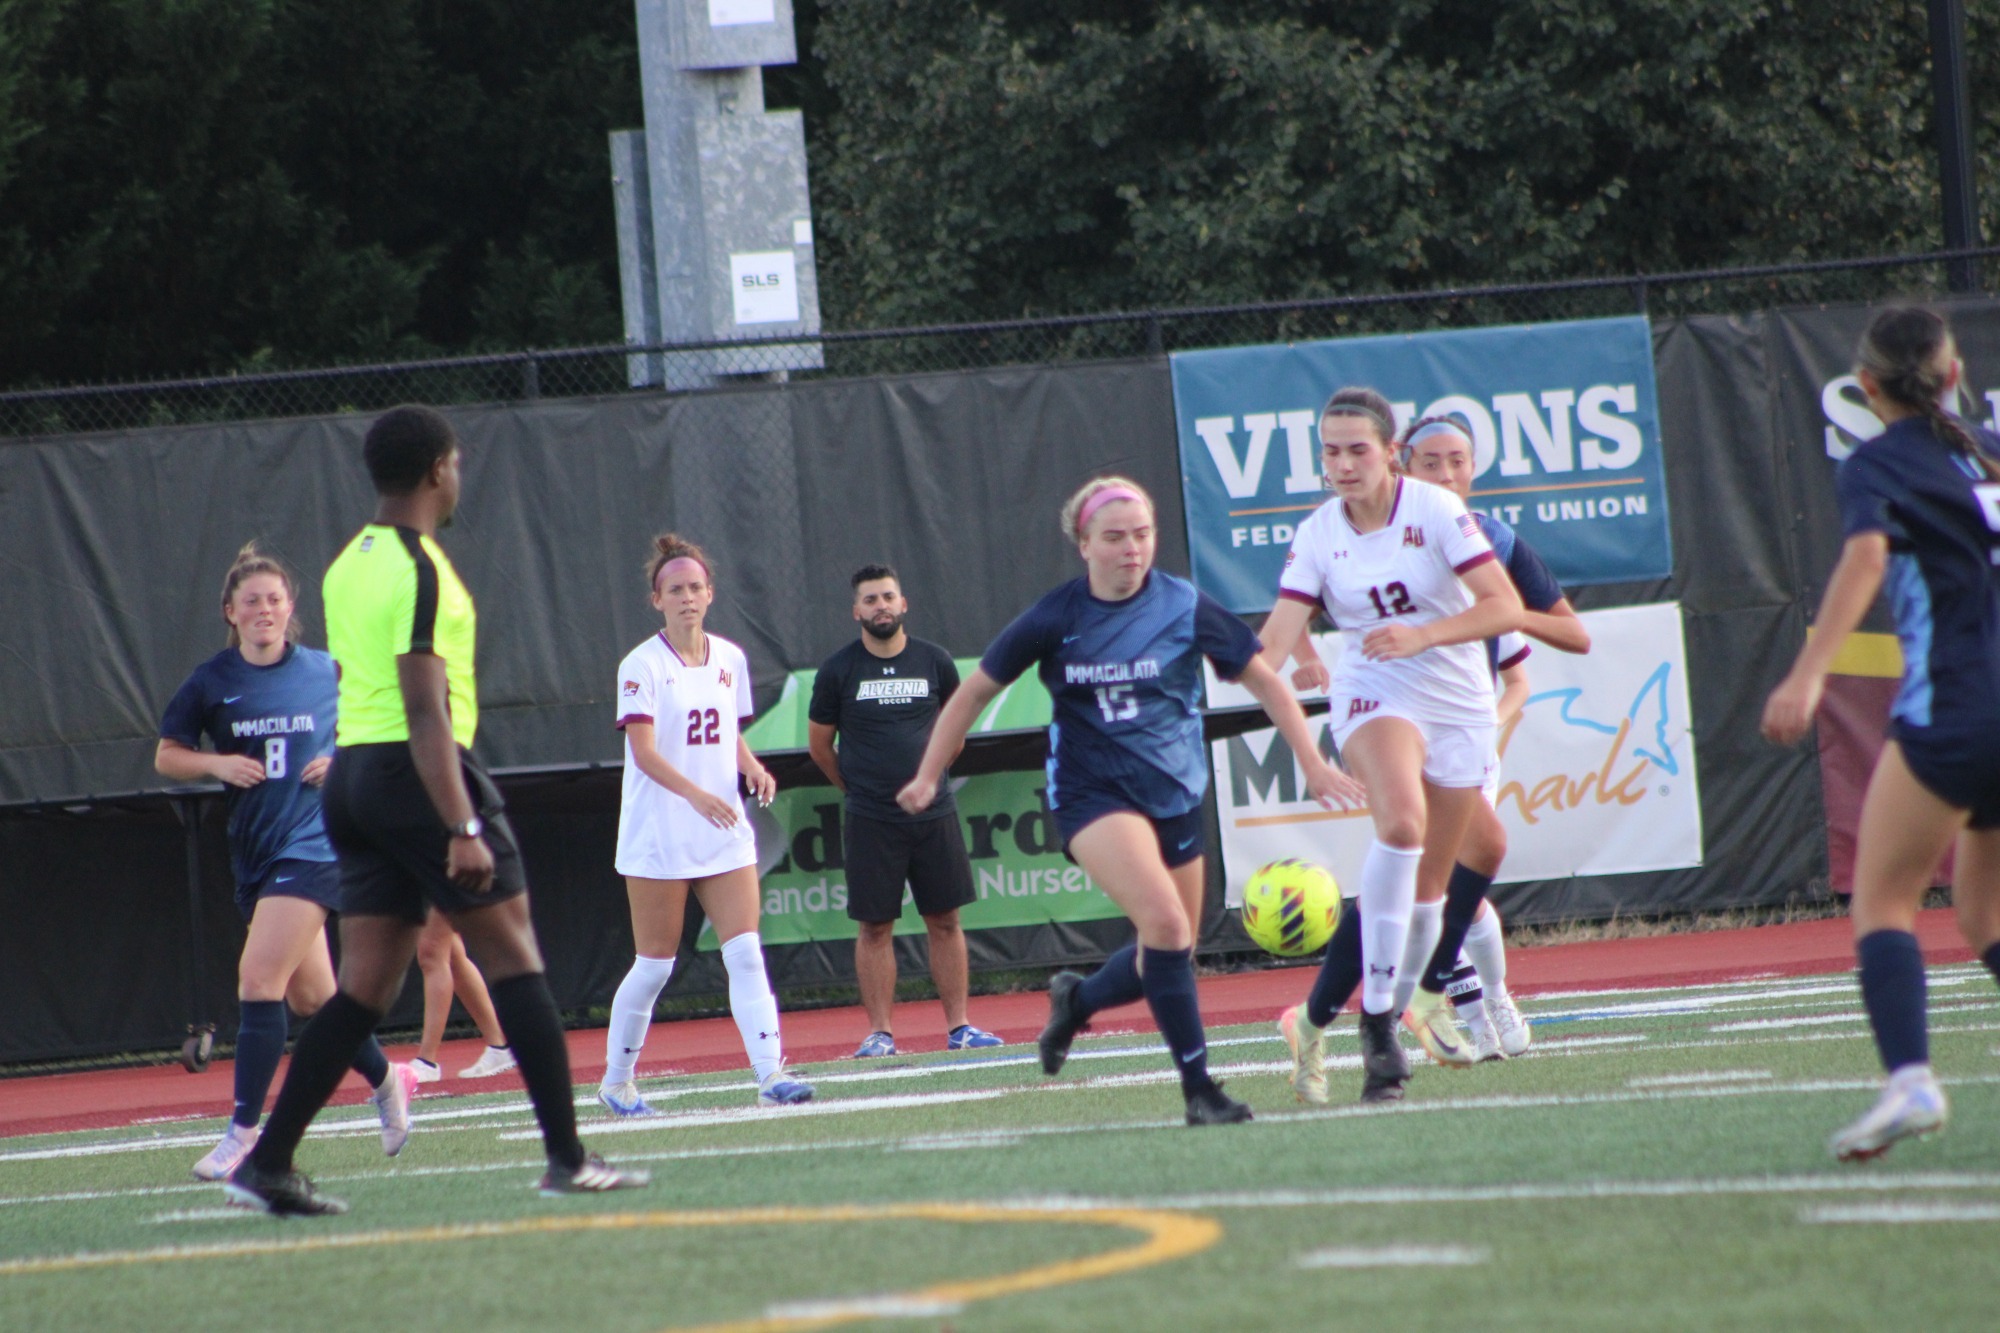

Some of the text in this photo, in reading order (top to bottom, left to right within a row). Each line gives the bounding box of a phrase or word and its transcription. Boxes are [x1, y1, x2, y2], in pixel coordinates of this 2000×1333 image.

[742, 273, 780, 287] SLS
[1195, 384, 1643, 499] VIONS
[1536, 496, 1647, 522] UNION
[1403, 526, 1425, 547] AU
[1368, 581, 1418, 619] 12
[719, 668, 732, 687] AU
[1065, 659, 1159, 684] IMMACULATA
[860, 681, 927, 698] ALVERNIA
[878, 697, 912, 705] SOCCER
[1094, 684, 1139, 722] 15
[231, 715, 314, 737] IMMACULATA
[687, 708, 720, 745] 22
[265, 738, 287, 778] 8
[978, 864, 1109, 899] Nurser
